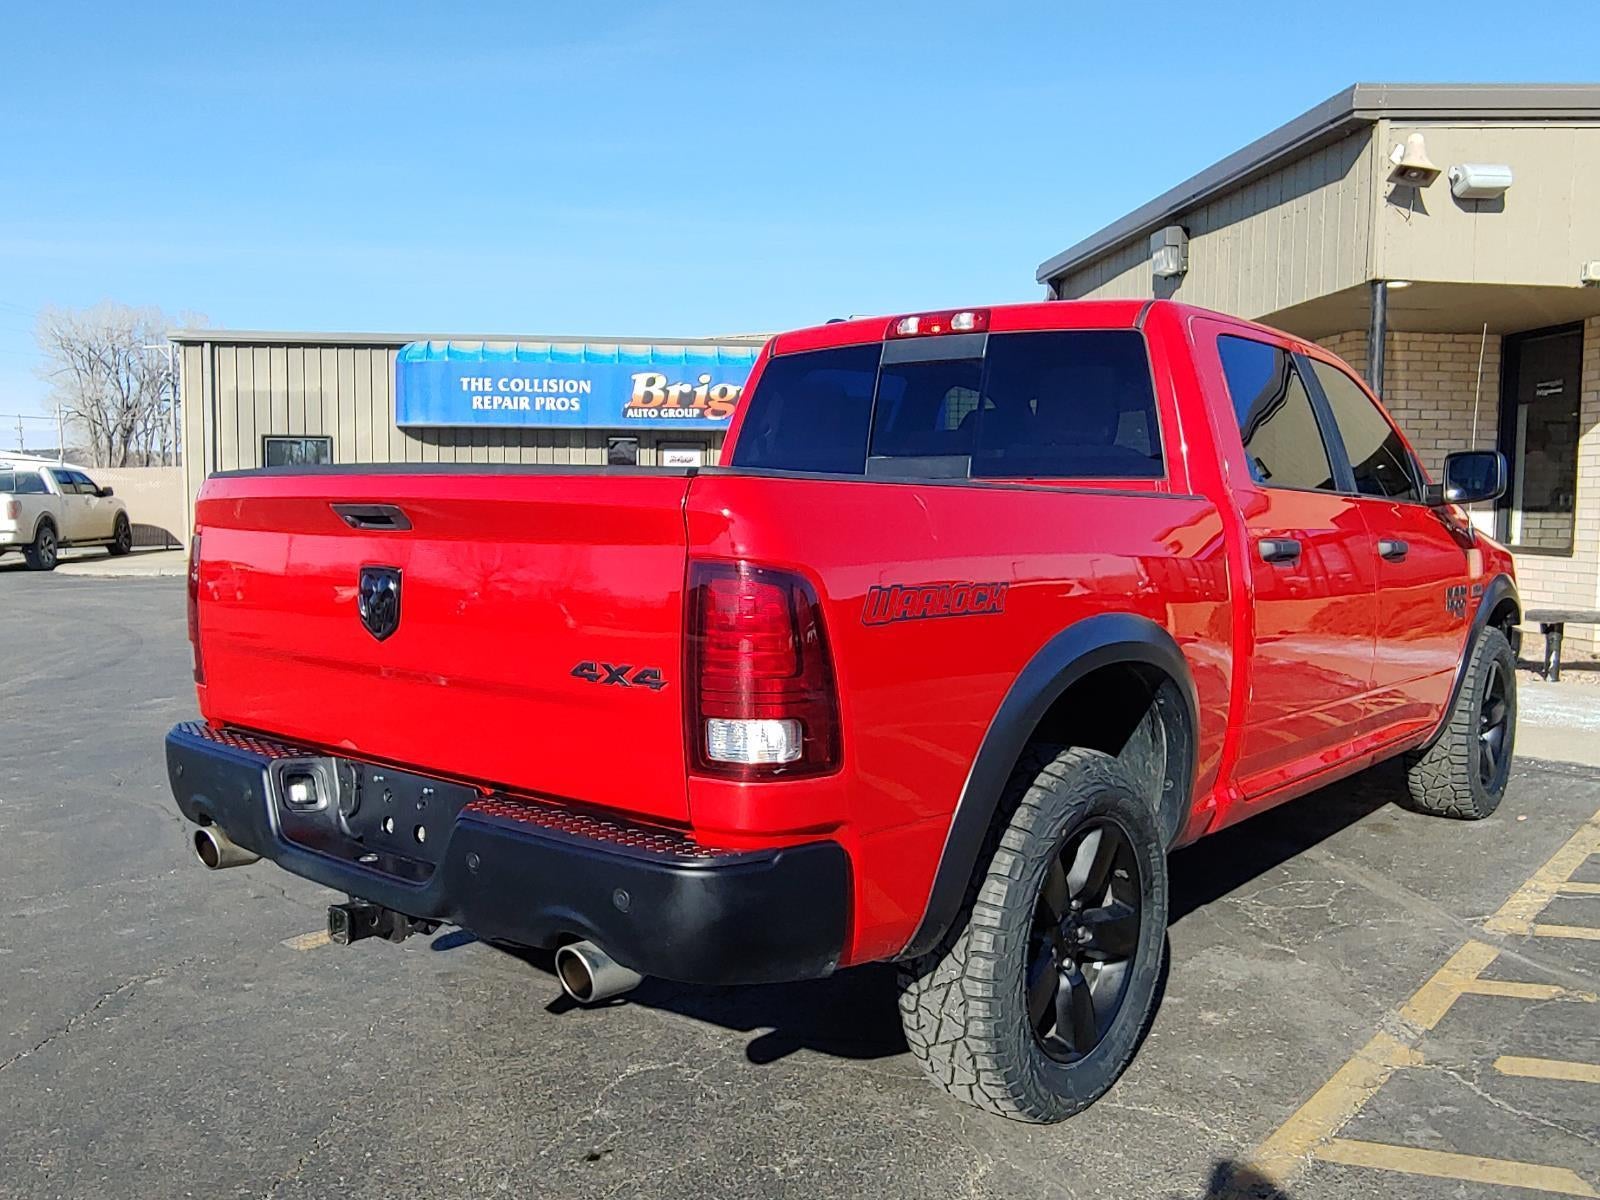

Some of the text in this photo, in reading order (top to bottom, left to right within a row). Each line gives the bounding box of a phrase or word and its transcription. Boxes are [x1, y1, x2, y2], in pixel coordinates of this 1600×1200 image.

[460, 377, 591, 394] THE COLLISION
[472, 395, 580, 411] REPAIR PROS
[625, 372, 743, 420] Brig
[626, 408, 700, 418] AUTO GROUP
[861, 582, 1009, 626] WARLOCK
